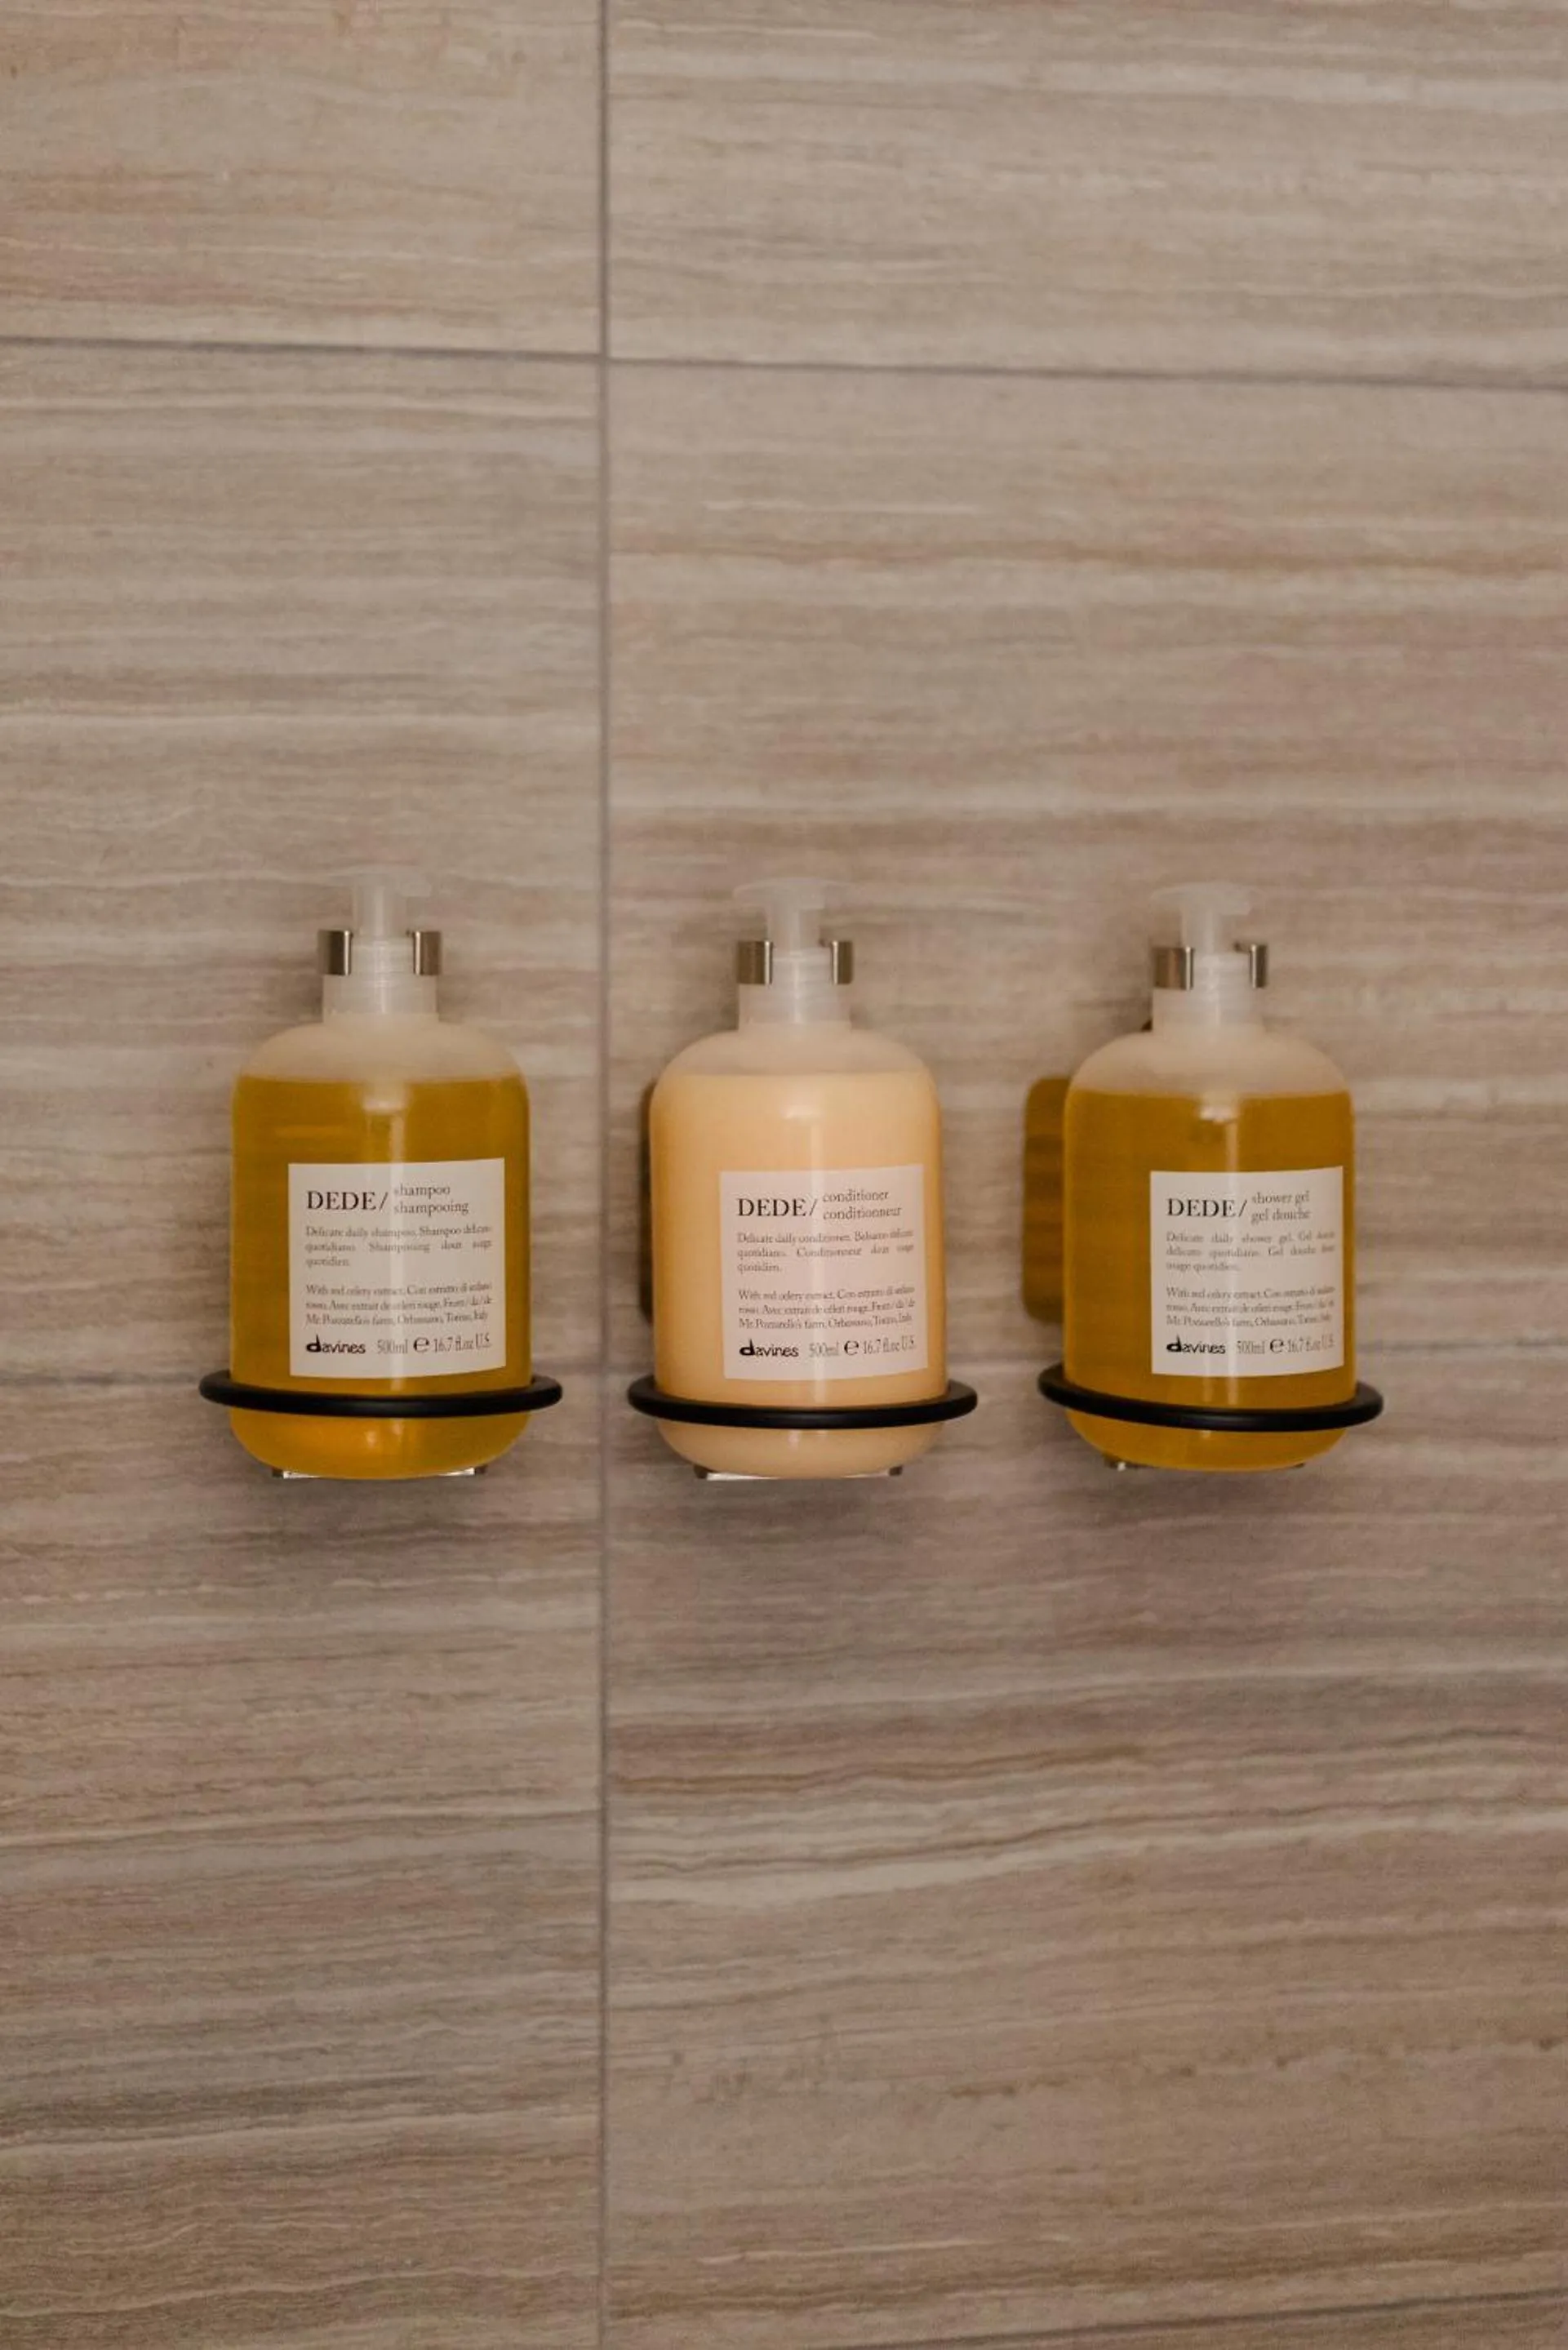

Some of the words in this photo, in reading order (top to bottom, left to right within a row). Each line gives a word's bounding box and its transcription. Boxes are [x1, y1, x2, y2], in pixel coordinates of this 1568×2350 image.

[306, 1190, 389, 1211] DEDE/
[393, 1184, 451, 1200] shampoo
[822, 1188, 889, 1203] conditioner
[1251, 1192, 1292, 1205] shower
[1295, 1190, 1310, 1205] gel
[393, 1199, 470, 1217] shampooing
[738, 1197, 817, 1217] DEDE/
[823, 1206, 902, 1220] conditionneur
[1167, 1197, 1248, 1218] DEDE/
[1250, 1207, 1269, 1227] gel
[1272, 1206, 1311, 1221] douche
[419, 1225, 462, 1237] Shampoo
[306, 1334, 366, 1354] davines
[376, 1339, 409, 1355] 500ml
[433, 1336, 454, 1352] 16.7
[739, 1339, 800, 1358] davines
[809, 1341, 840, 1358] 500ml
[862, 1338, 882, 1355] 16.7
[1166, 1334, 1226, 1354] davines
[1237, 1339, 1266, 1355] 500ml
